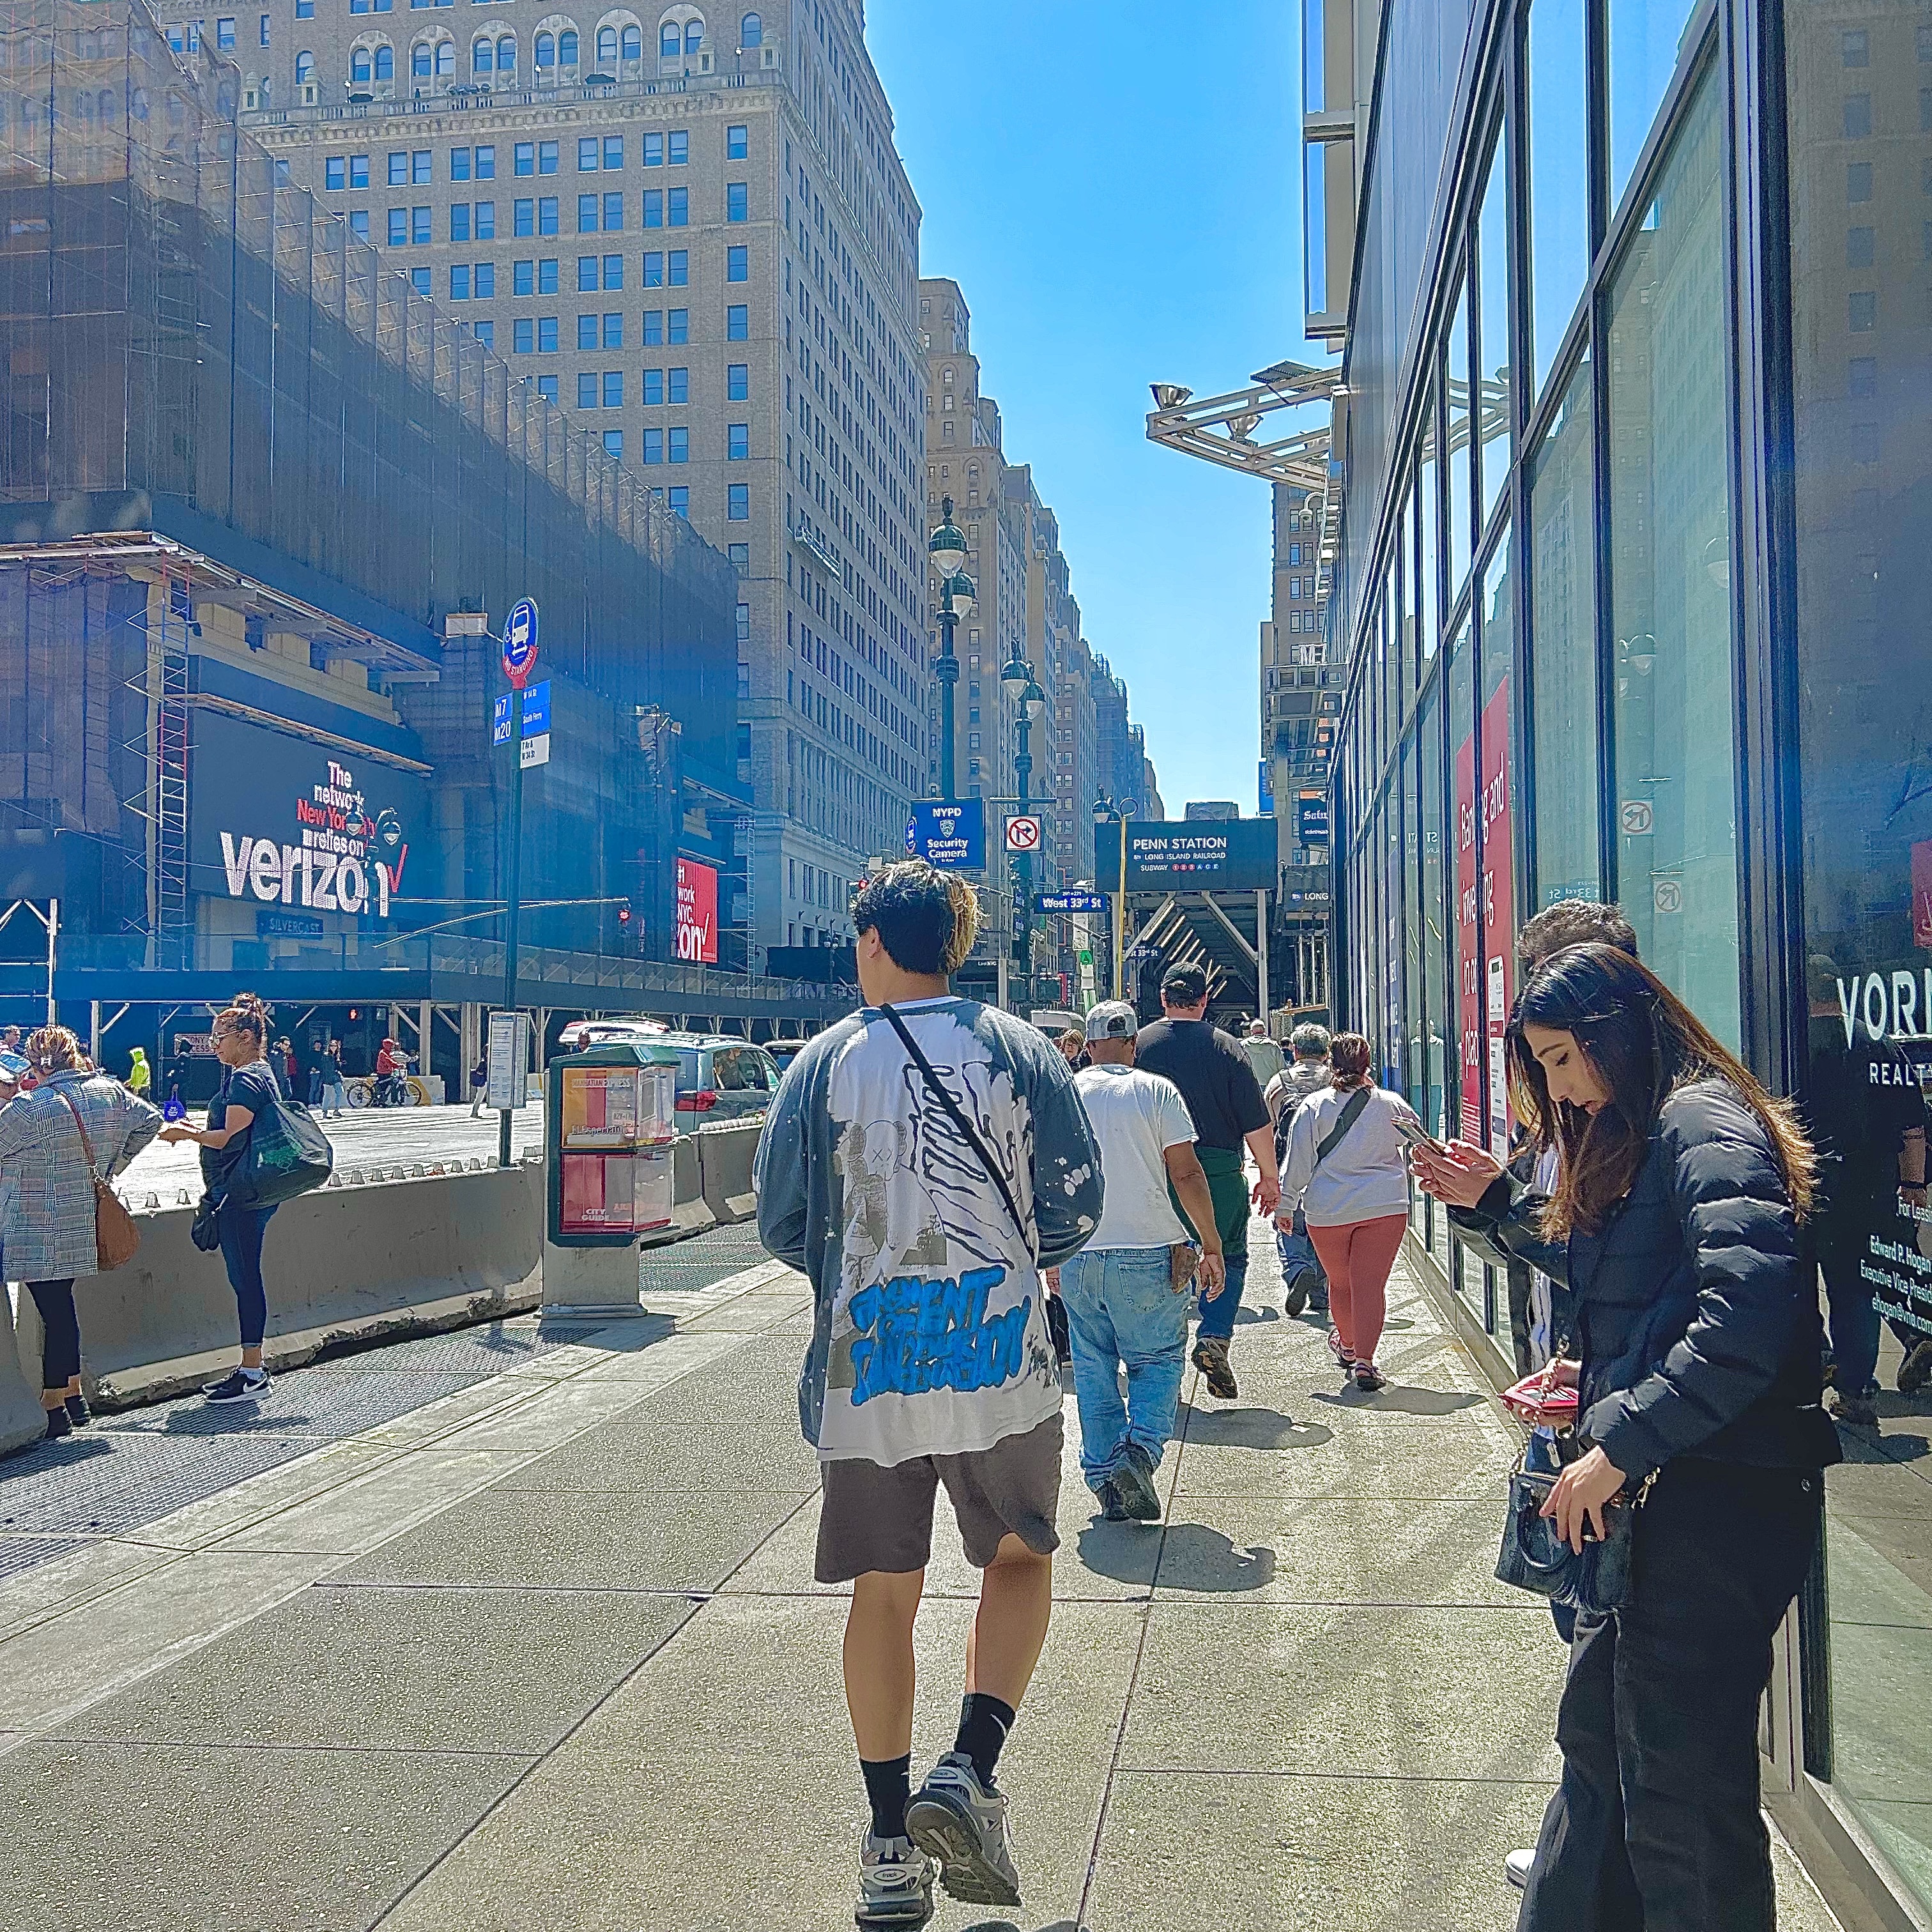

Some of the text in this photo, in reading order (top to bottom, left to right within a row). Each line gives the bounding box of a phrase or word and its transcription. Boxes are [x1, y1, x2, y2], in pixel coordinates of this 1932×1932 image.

[511, 649, 533, 675] STANDING
[496, 698, 507, 717] M7
[494, 721, 511, 741] M20
[327, 760, 352, 788] The
[1489, 751, 1504, 823] and
[296, 798, 326, 827] New
[327, 805, 346, 831] Yor
[932, 808, 962, 818] NYPD
[313, 828, 364, 857] relies on
[927, 838, 969, 849] Security
[928, 849, 968, 858] Camera
[1133, 837, 1227, 850] PENN STATION
[220, 831, 389, 917] verizon
[1042, 896, 1102, 908] West 33rd St
[1869, 1062, 1931, 1087] REALT
[1897, 1196, 1911, 1218] For
[1870, 1234, 1931, 1276] Edward P. Hogan
[1860, 1259, 1892, 1289] Executive
[1892, 1271, 1908, 1294] Vice
